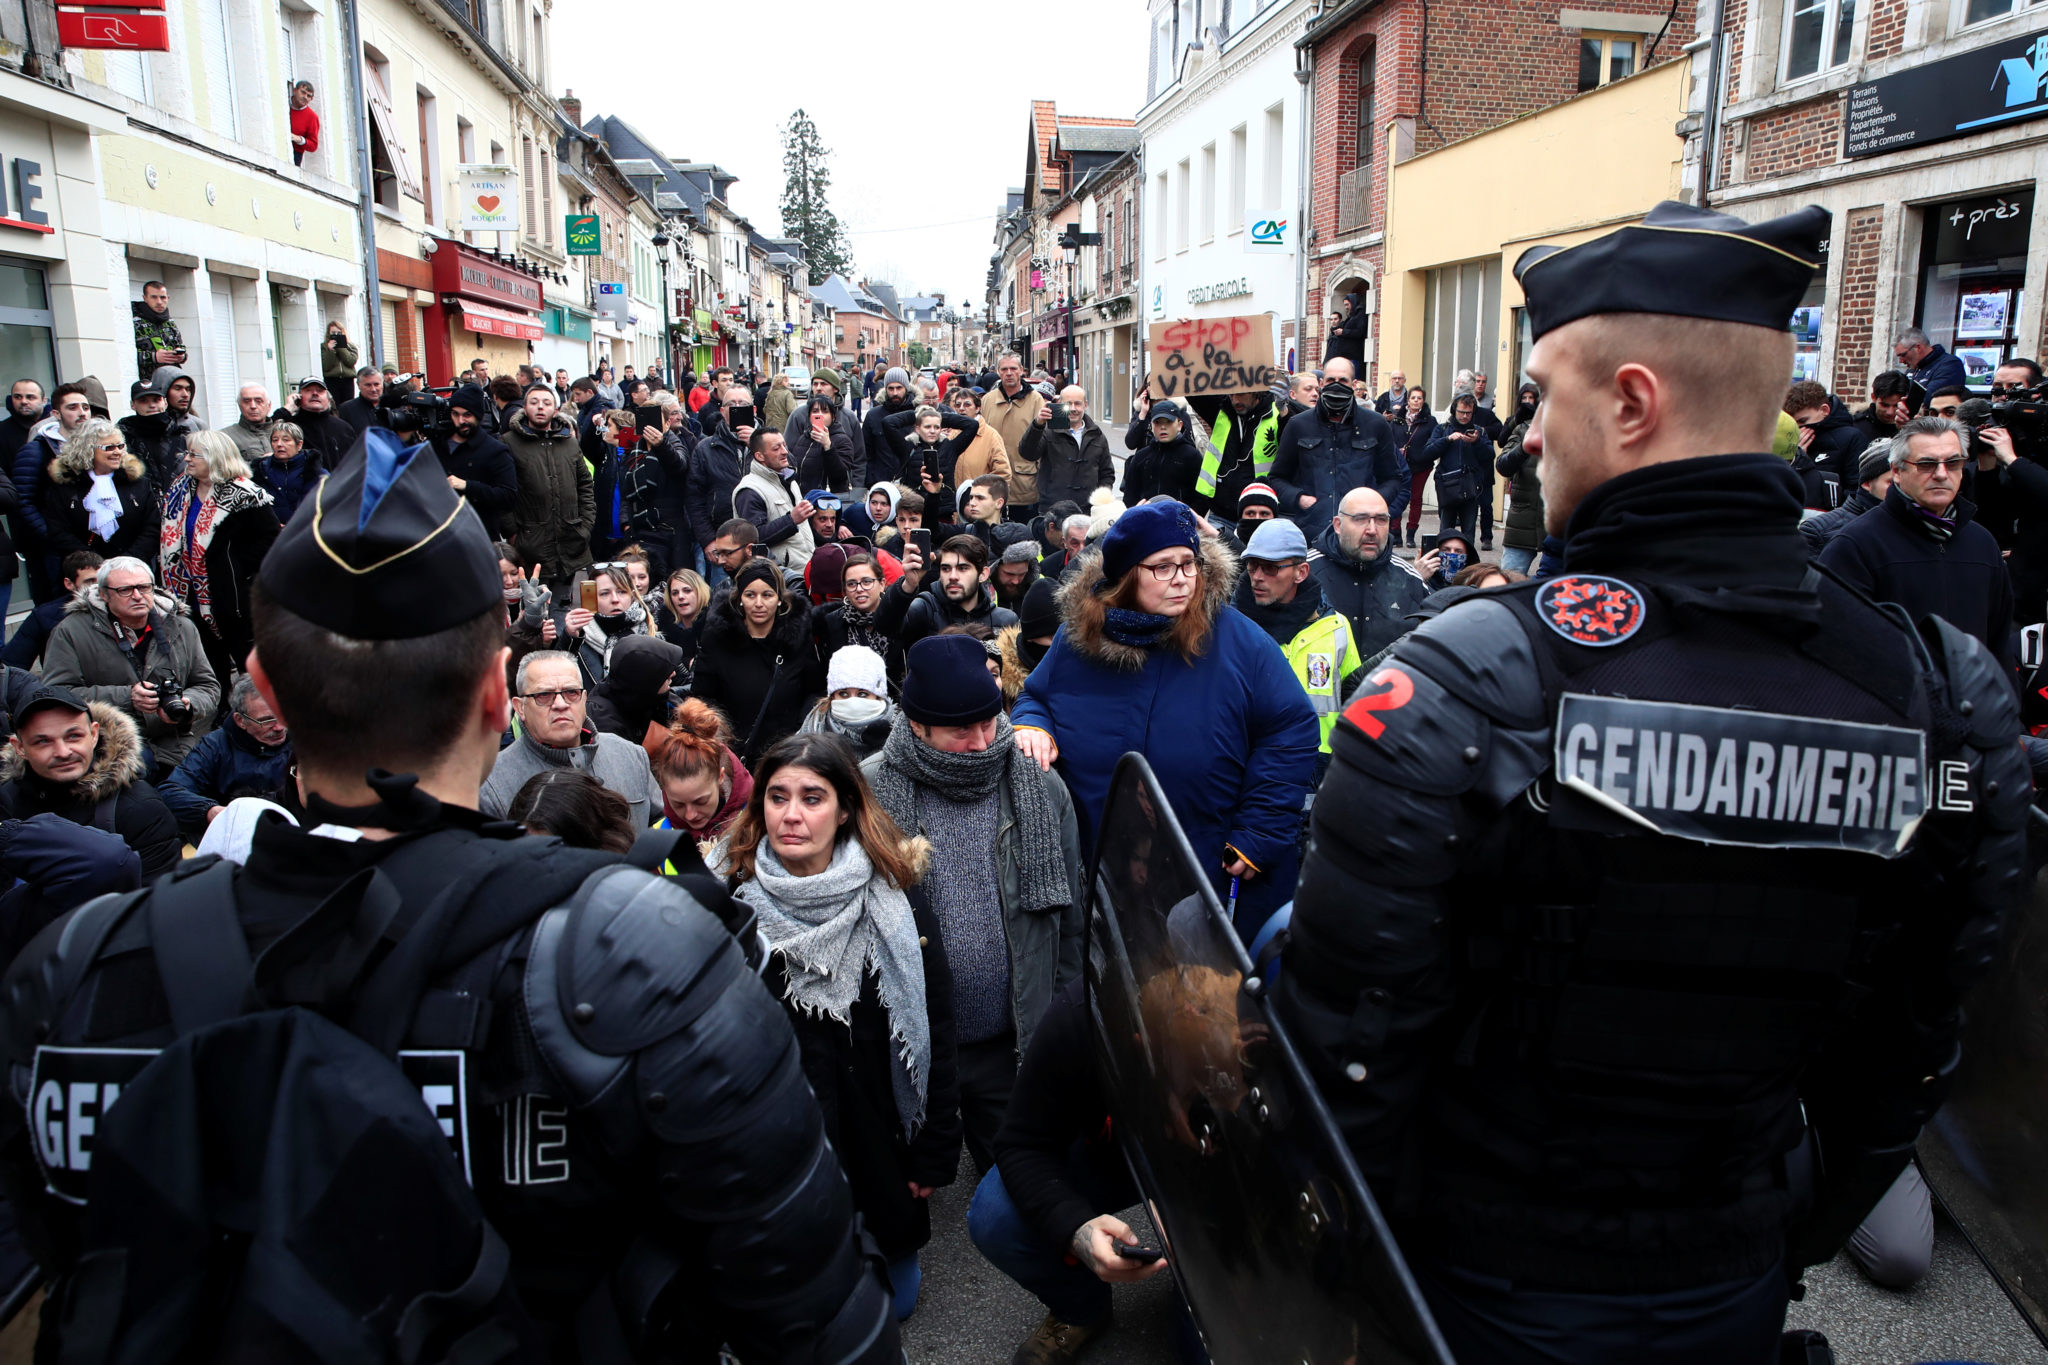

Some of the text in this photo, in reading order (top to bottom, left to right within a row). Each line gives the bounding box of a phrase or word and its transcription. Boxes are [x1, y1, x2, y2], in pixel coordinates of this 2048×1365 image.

[1852, 85, 1877, 99] Terrains
[1851, 96, 1879, 110] Maisons
[1849, 112, 1897, 133] Appartements
[1850, 105, 1883, 121] Propriétés
[1848, 130, 1915, 152] Fonds de commerce
[1849, 126, 1885, 142] Immeubles
[471, 182, 505, 190] ARTISAN
[1966, 199, 2020, 240] près
[601, 284, 621, 293] CIC
[1211, 277, 1247, 300] AGRICOLE
[1203, 342, 1243, 369] la
[113, 621, 124, 639] Canon
[1342, 668, 1414, 740] 2
[1564, 722, 1918, 831] GENDARMERIE
